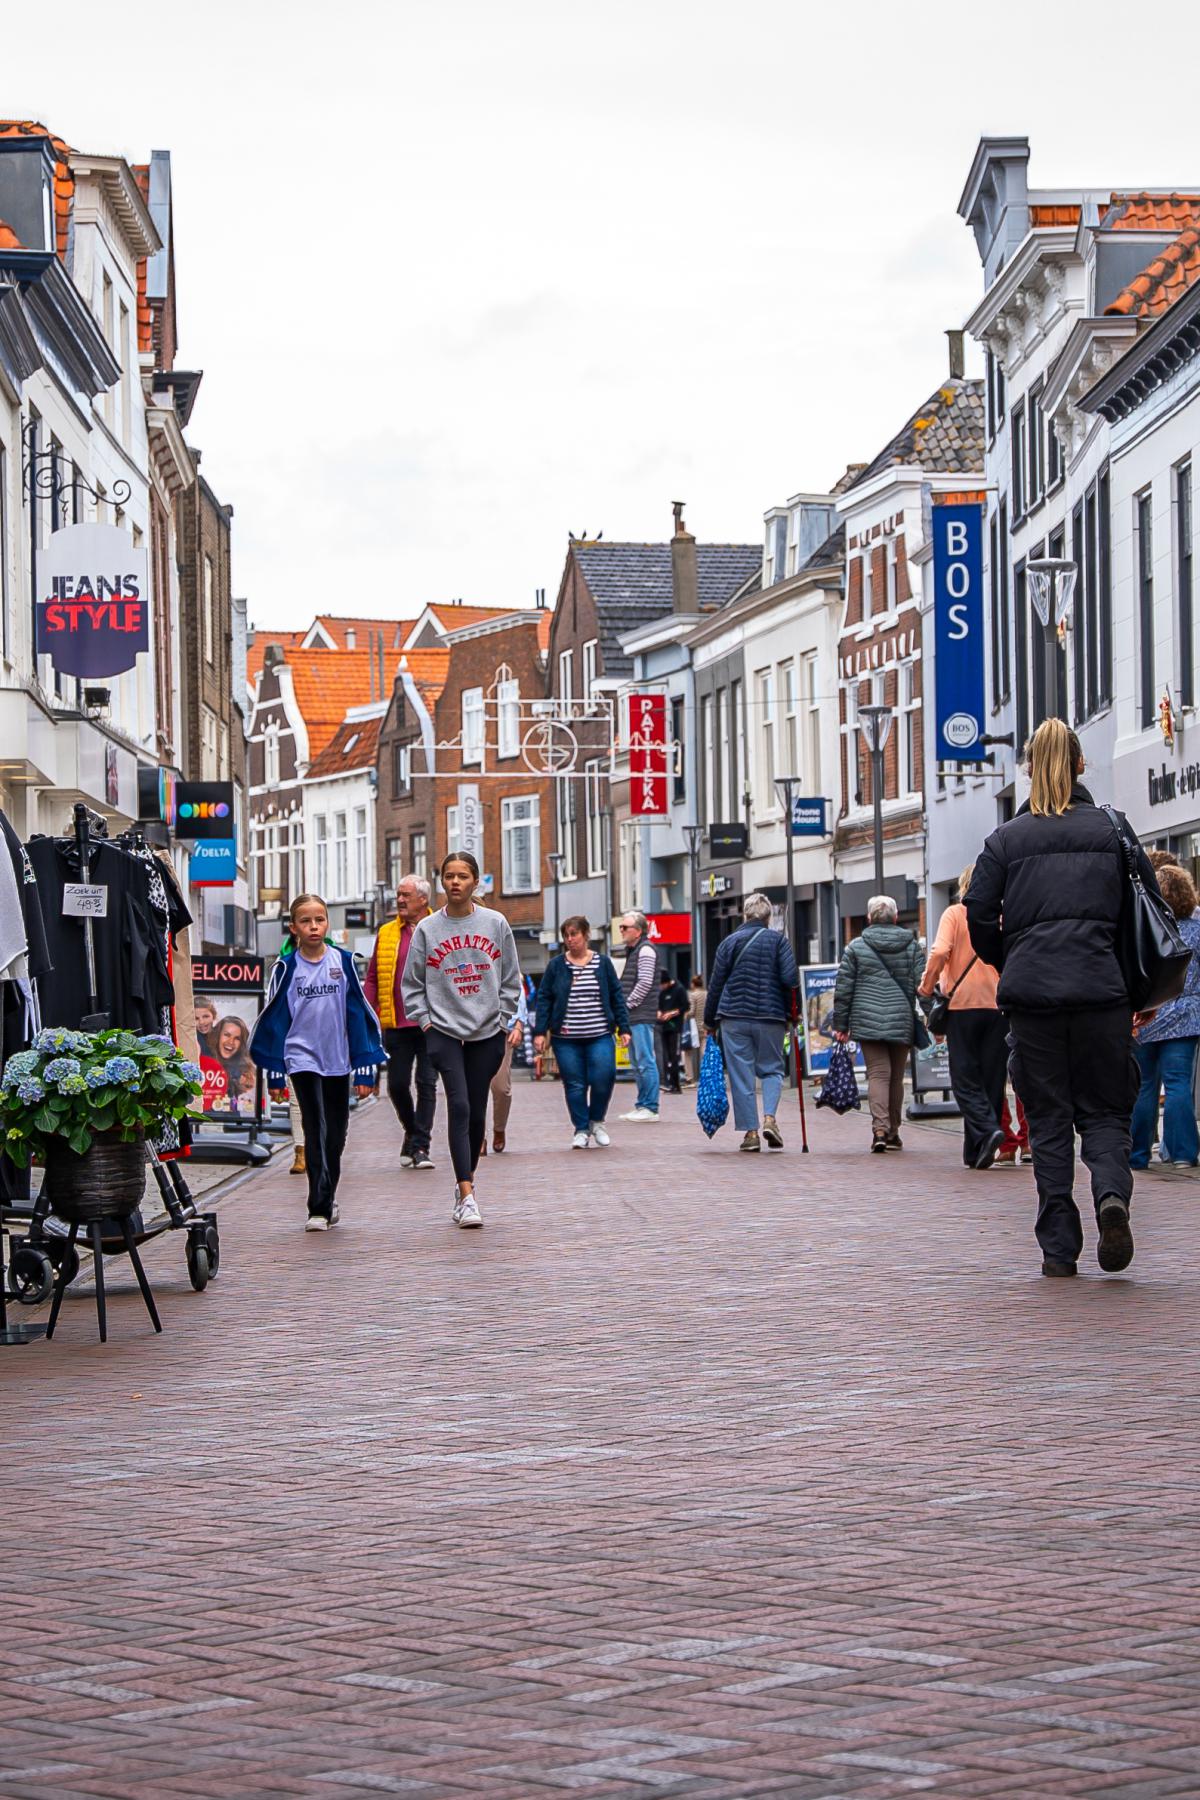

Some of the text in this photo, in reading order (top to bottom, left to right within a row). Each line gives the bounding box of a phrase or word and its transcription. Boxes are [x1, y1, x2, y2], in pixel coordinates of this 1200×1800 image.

[45, 574, 140, 602] JEANS
[946, 521, 970, 640] BOS
[45, 603, 141, 632] STYLE
[952, 724, 971, 732] BOS
[793, 808, 821, 817] Phone
[201, 848, 231, 858] DELTA
[427, 934, 501, 969] MANHATTAN
[192, 964, 260, 981] ELKOM
[297, 984, 340, 998] Rakuten
[458, 985, 479, 995] NYC
